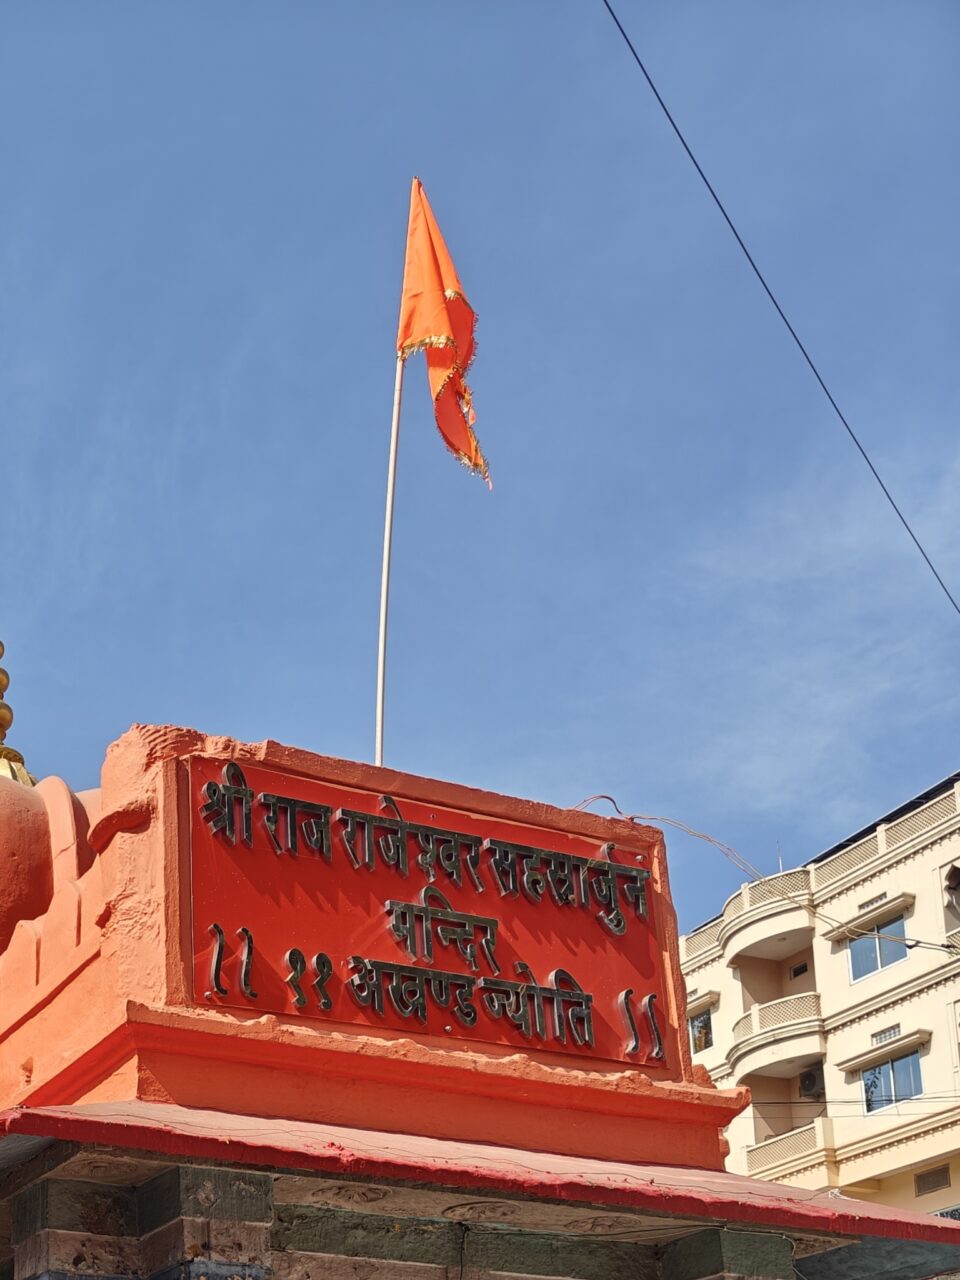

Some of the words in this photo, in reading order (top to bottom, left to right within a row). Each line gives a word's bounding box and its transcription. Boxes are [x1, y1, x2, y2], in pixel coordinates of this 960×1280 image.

[199, 761, 254, 848] श्री
[384, 885, 501, 976] मन्दिर
[344, 955, 478, 1028] अखण्ड
[478, 961, 596, 1048] ज्योति
